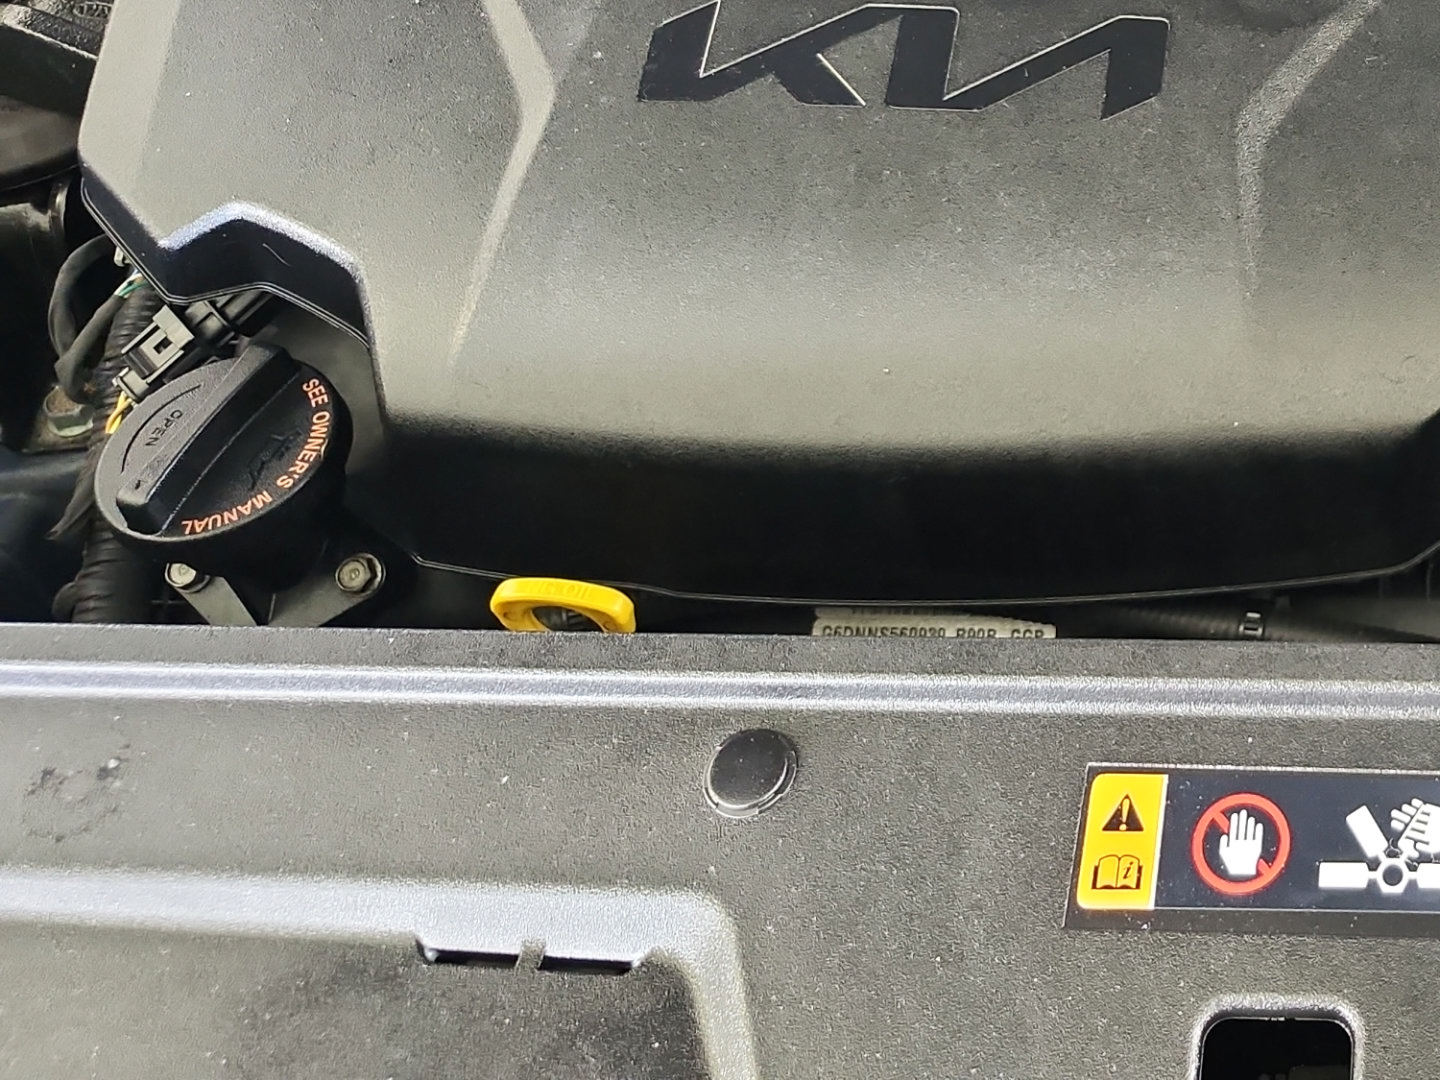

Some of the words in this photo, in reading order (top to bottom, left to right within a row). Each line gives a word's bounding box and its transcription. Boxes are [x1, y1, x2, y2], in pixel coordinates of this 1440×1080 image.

[302, 377, 329, 408] SEE
[145, 409, 184, 447] OPEN
[276, 410, 331, 489] OWNER'S
[181, 490, 273, 536] MANUAL
